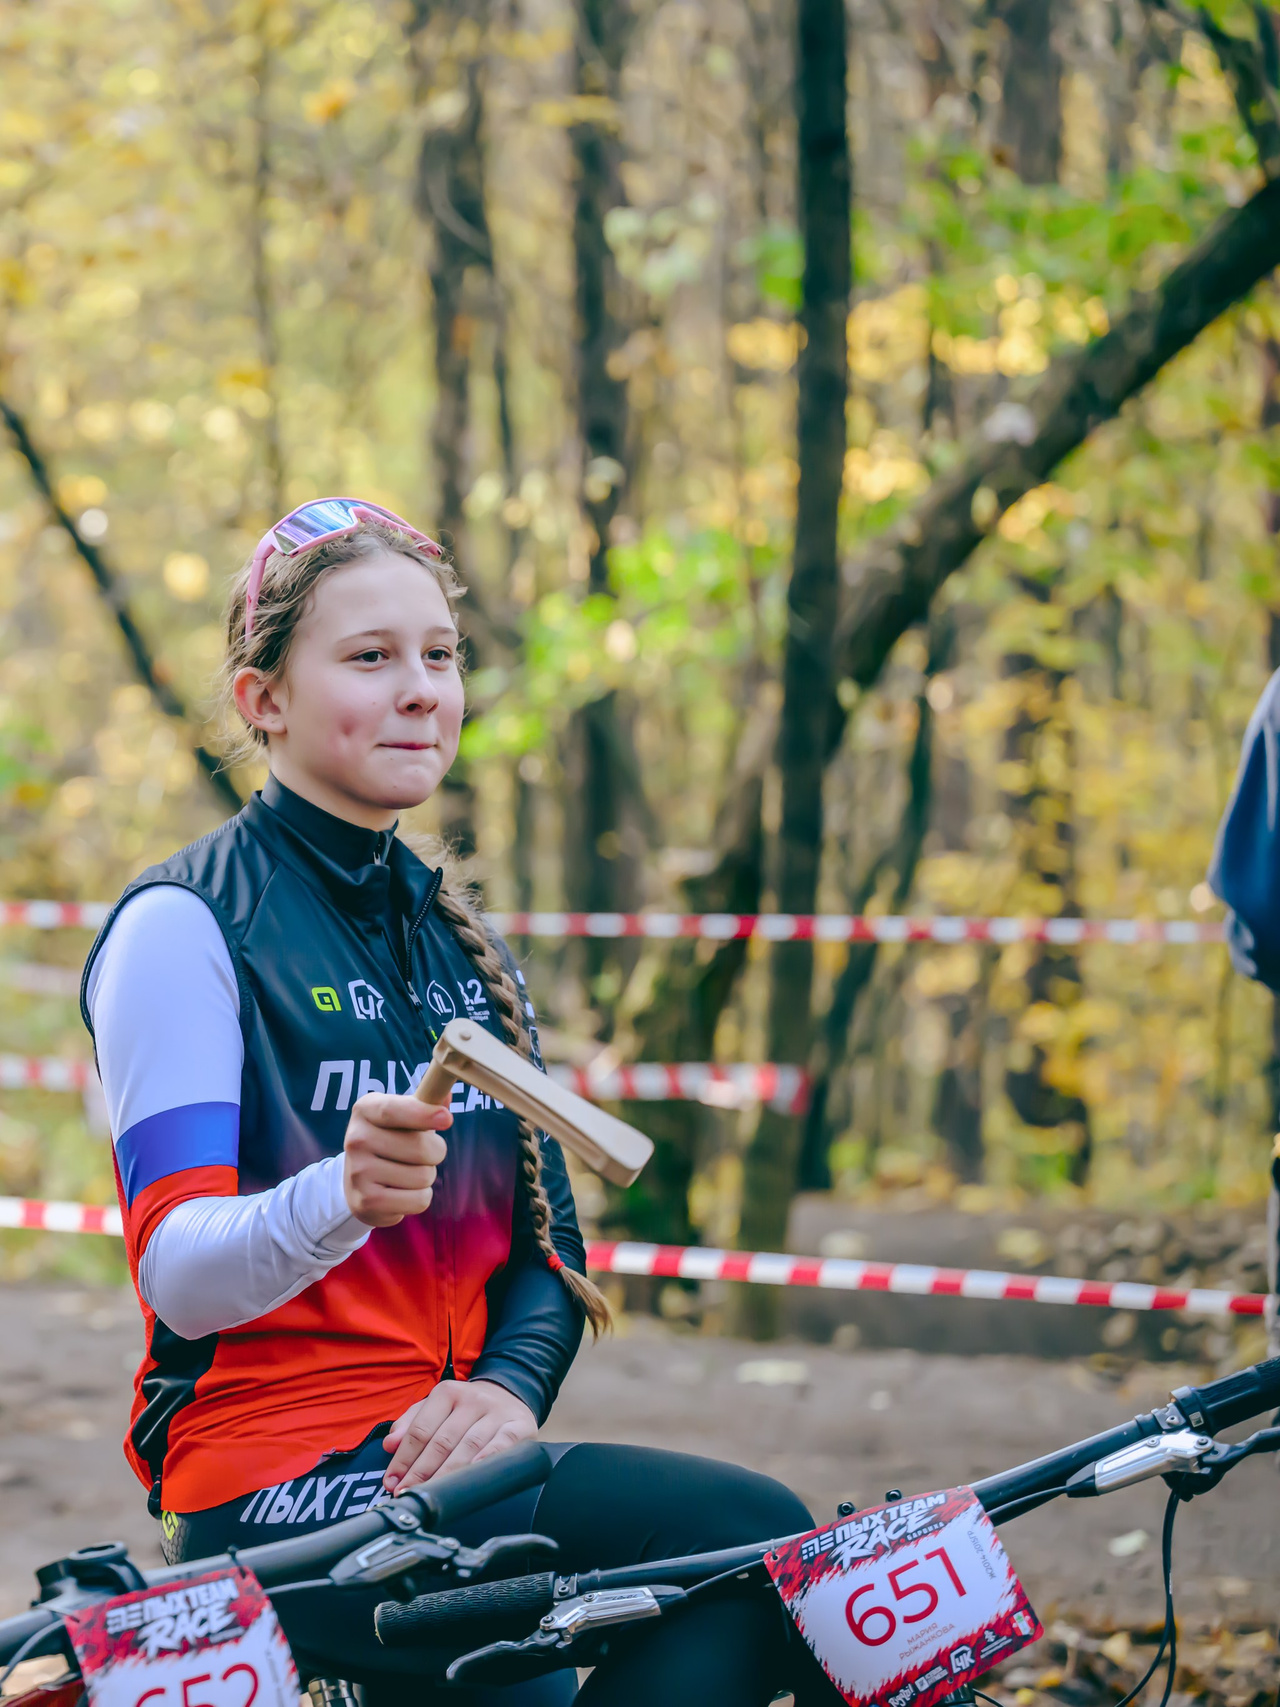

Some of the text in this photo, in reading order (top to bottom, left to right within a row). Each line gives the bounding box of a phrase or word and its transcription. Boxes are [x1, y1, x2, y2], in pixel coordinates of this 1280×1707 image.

[828, 1511, 938, 1570] RACE
[845, 1546, 967, 1647] 651
[906, 1622, 939, 1645] МАРИЯ
